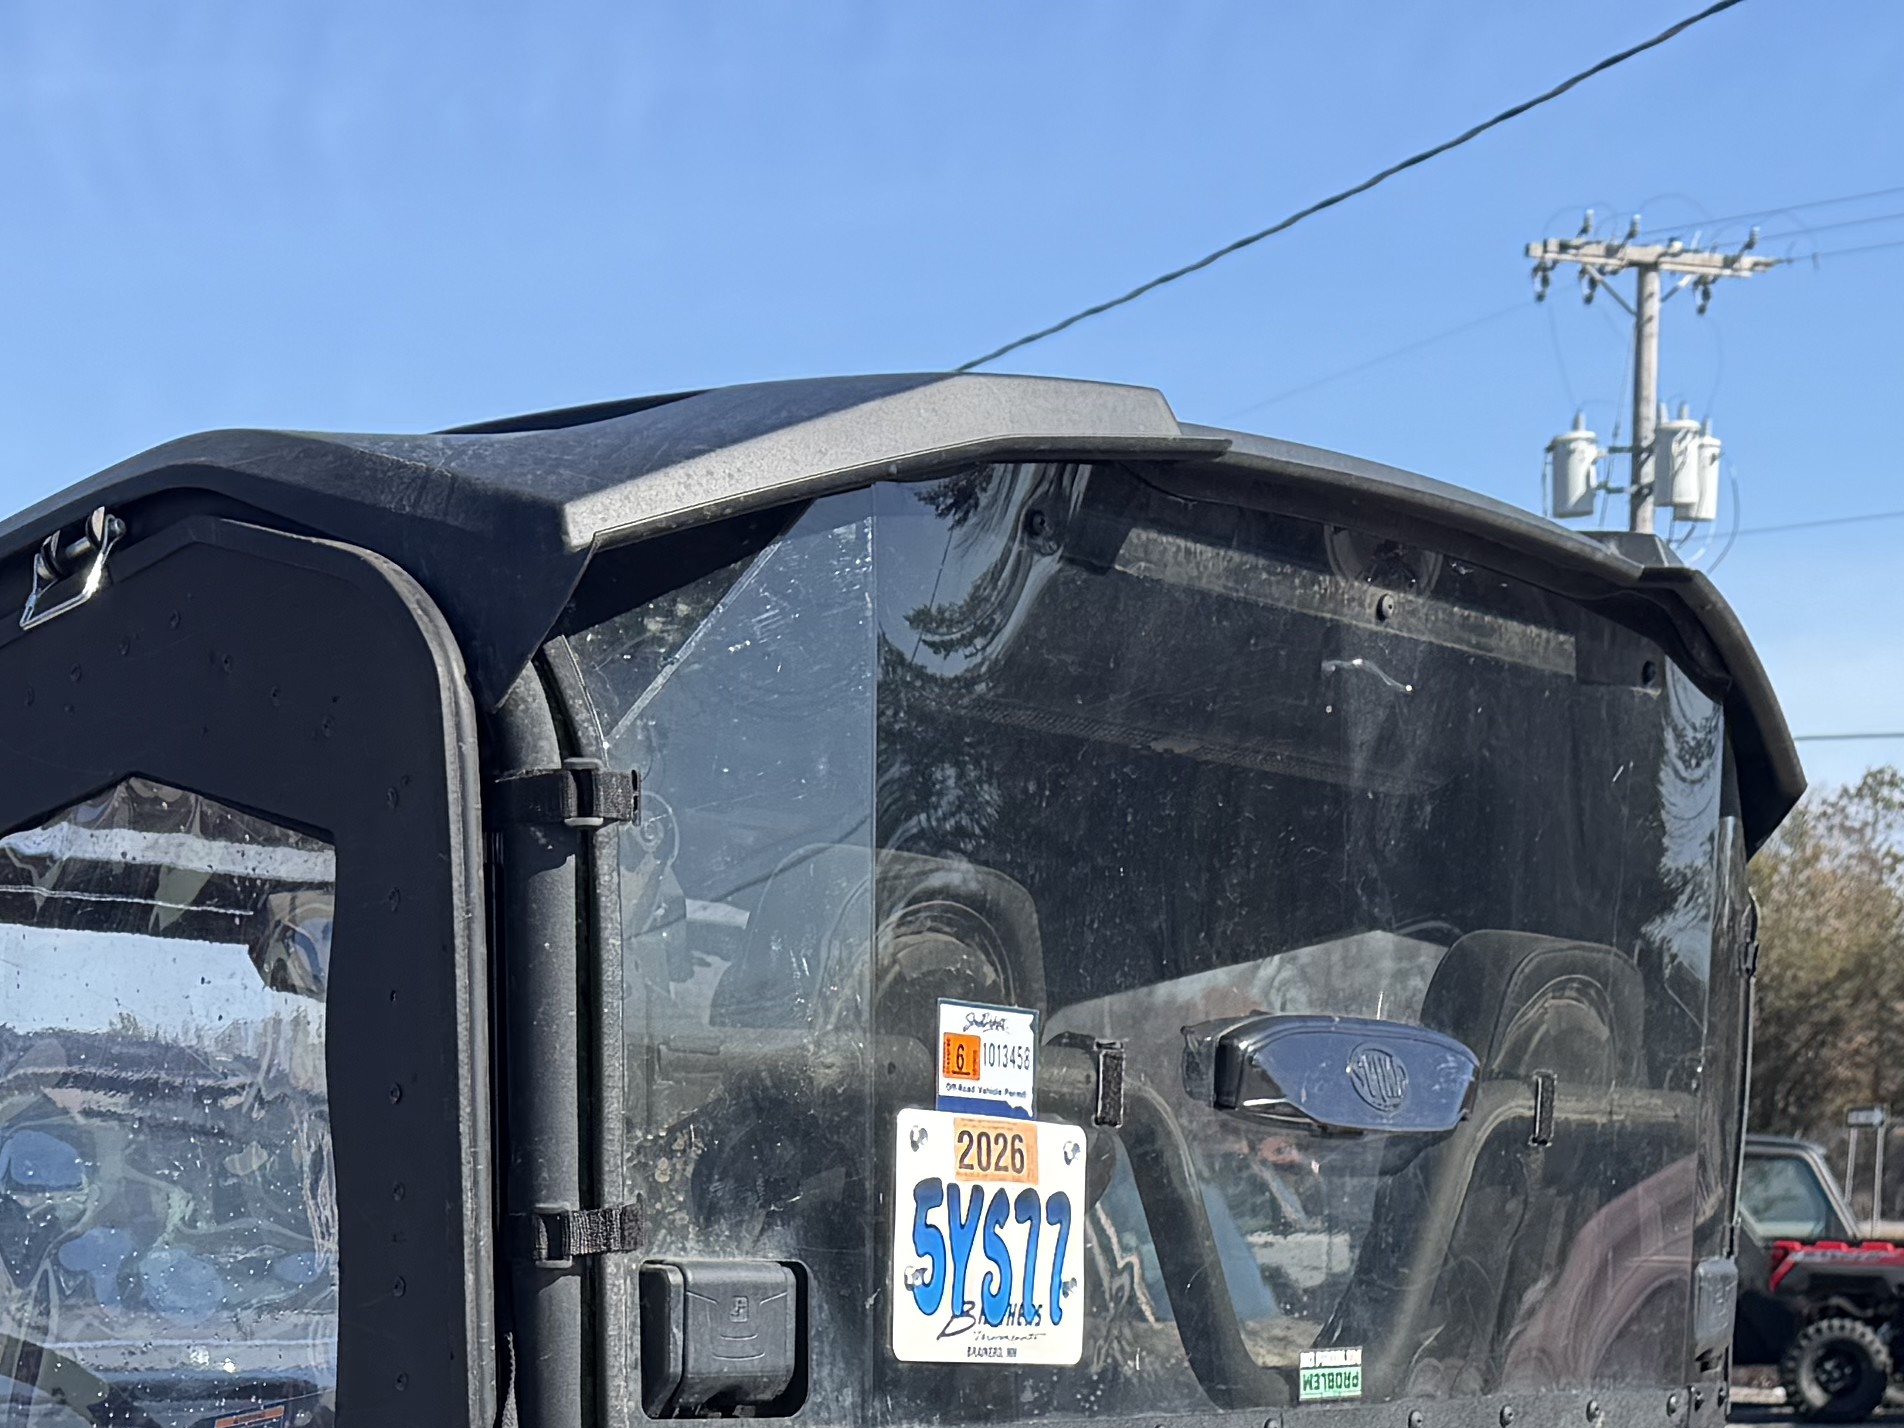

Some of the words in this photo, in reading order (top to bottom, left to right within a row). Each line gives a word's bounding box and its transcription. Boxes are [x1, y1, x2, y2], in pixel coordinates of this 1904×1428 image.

[956, 1043, 965, 1071] 6
[982, 1042, 1031, 1071] 1013458
[957, 1129, 1025, 1175] 2026
[1303, 1371, 1359, 1392] PROBLEM
